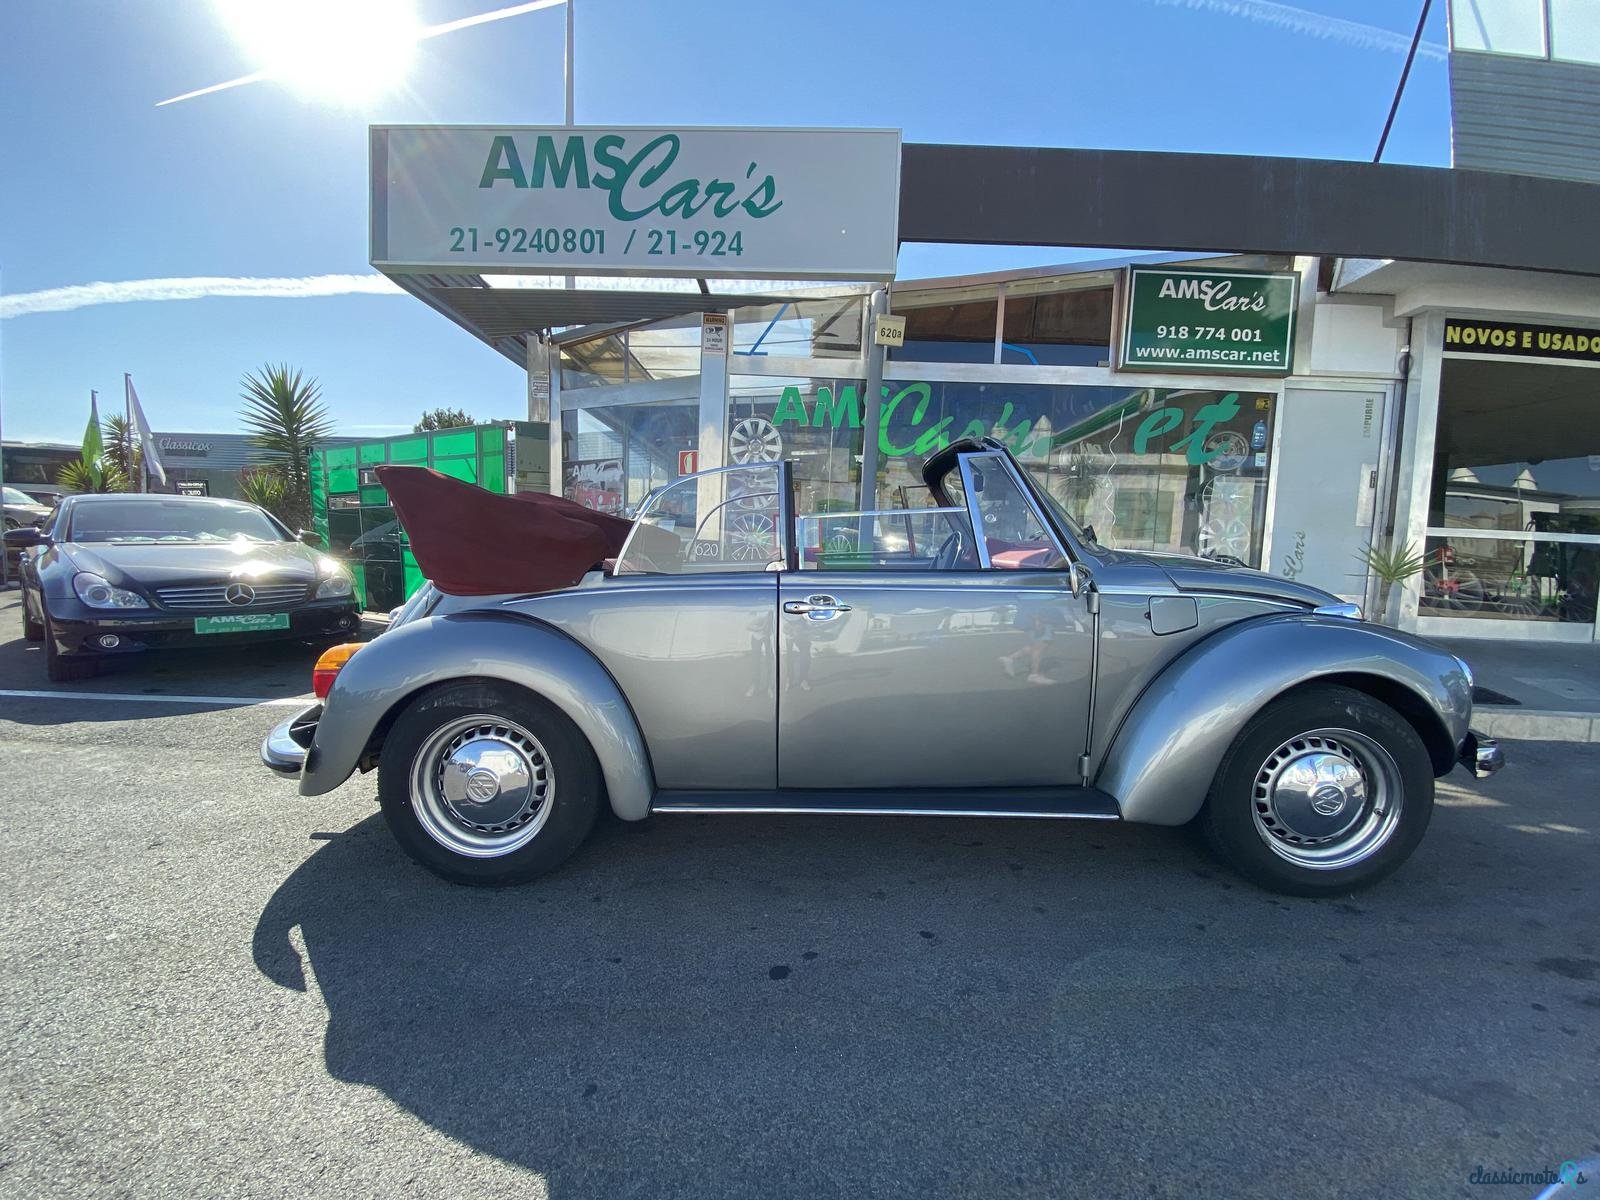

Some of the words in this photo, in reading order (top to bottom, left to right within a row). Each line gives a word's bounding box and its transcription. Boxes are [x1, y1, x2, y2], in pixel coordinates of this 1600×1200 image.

[450, 227, 605, 255] 21-9240801
[647, 229, 744, 257] 21-924
[1156, 325, 1189, 339] 918
[1194, 327, 1226, 341] 774
[1231, 328, 1262, 342] 001
[1445, 325, 1517, 348] NOVOS
[1522, 331, 1533, 348] E
[1135, 347, 1280, 362] www.amscar.net
[695, 542, 719, 557] 620
